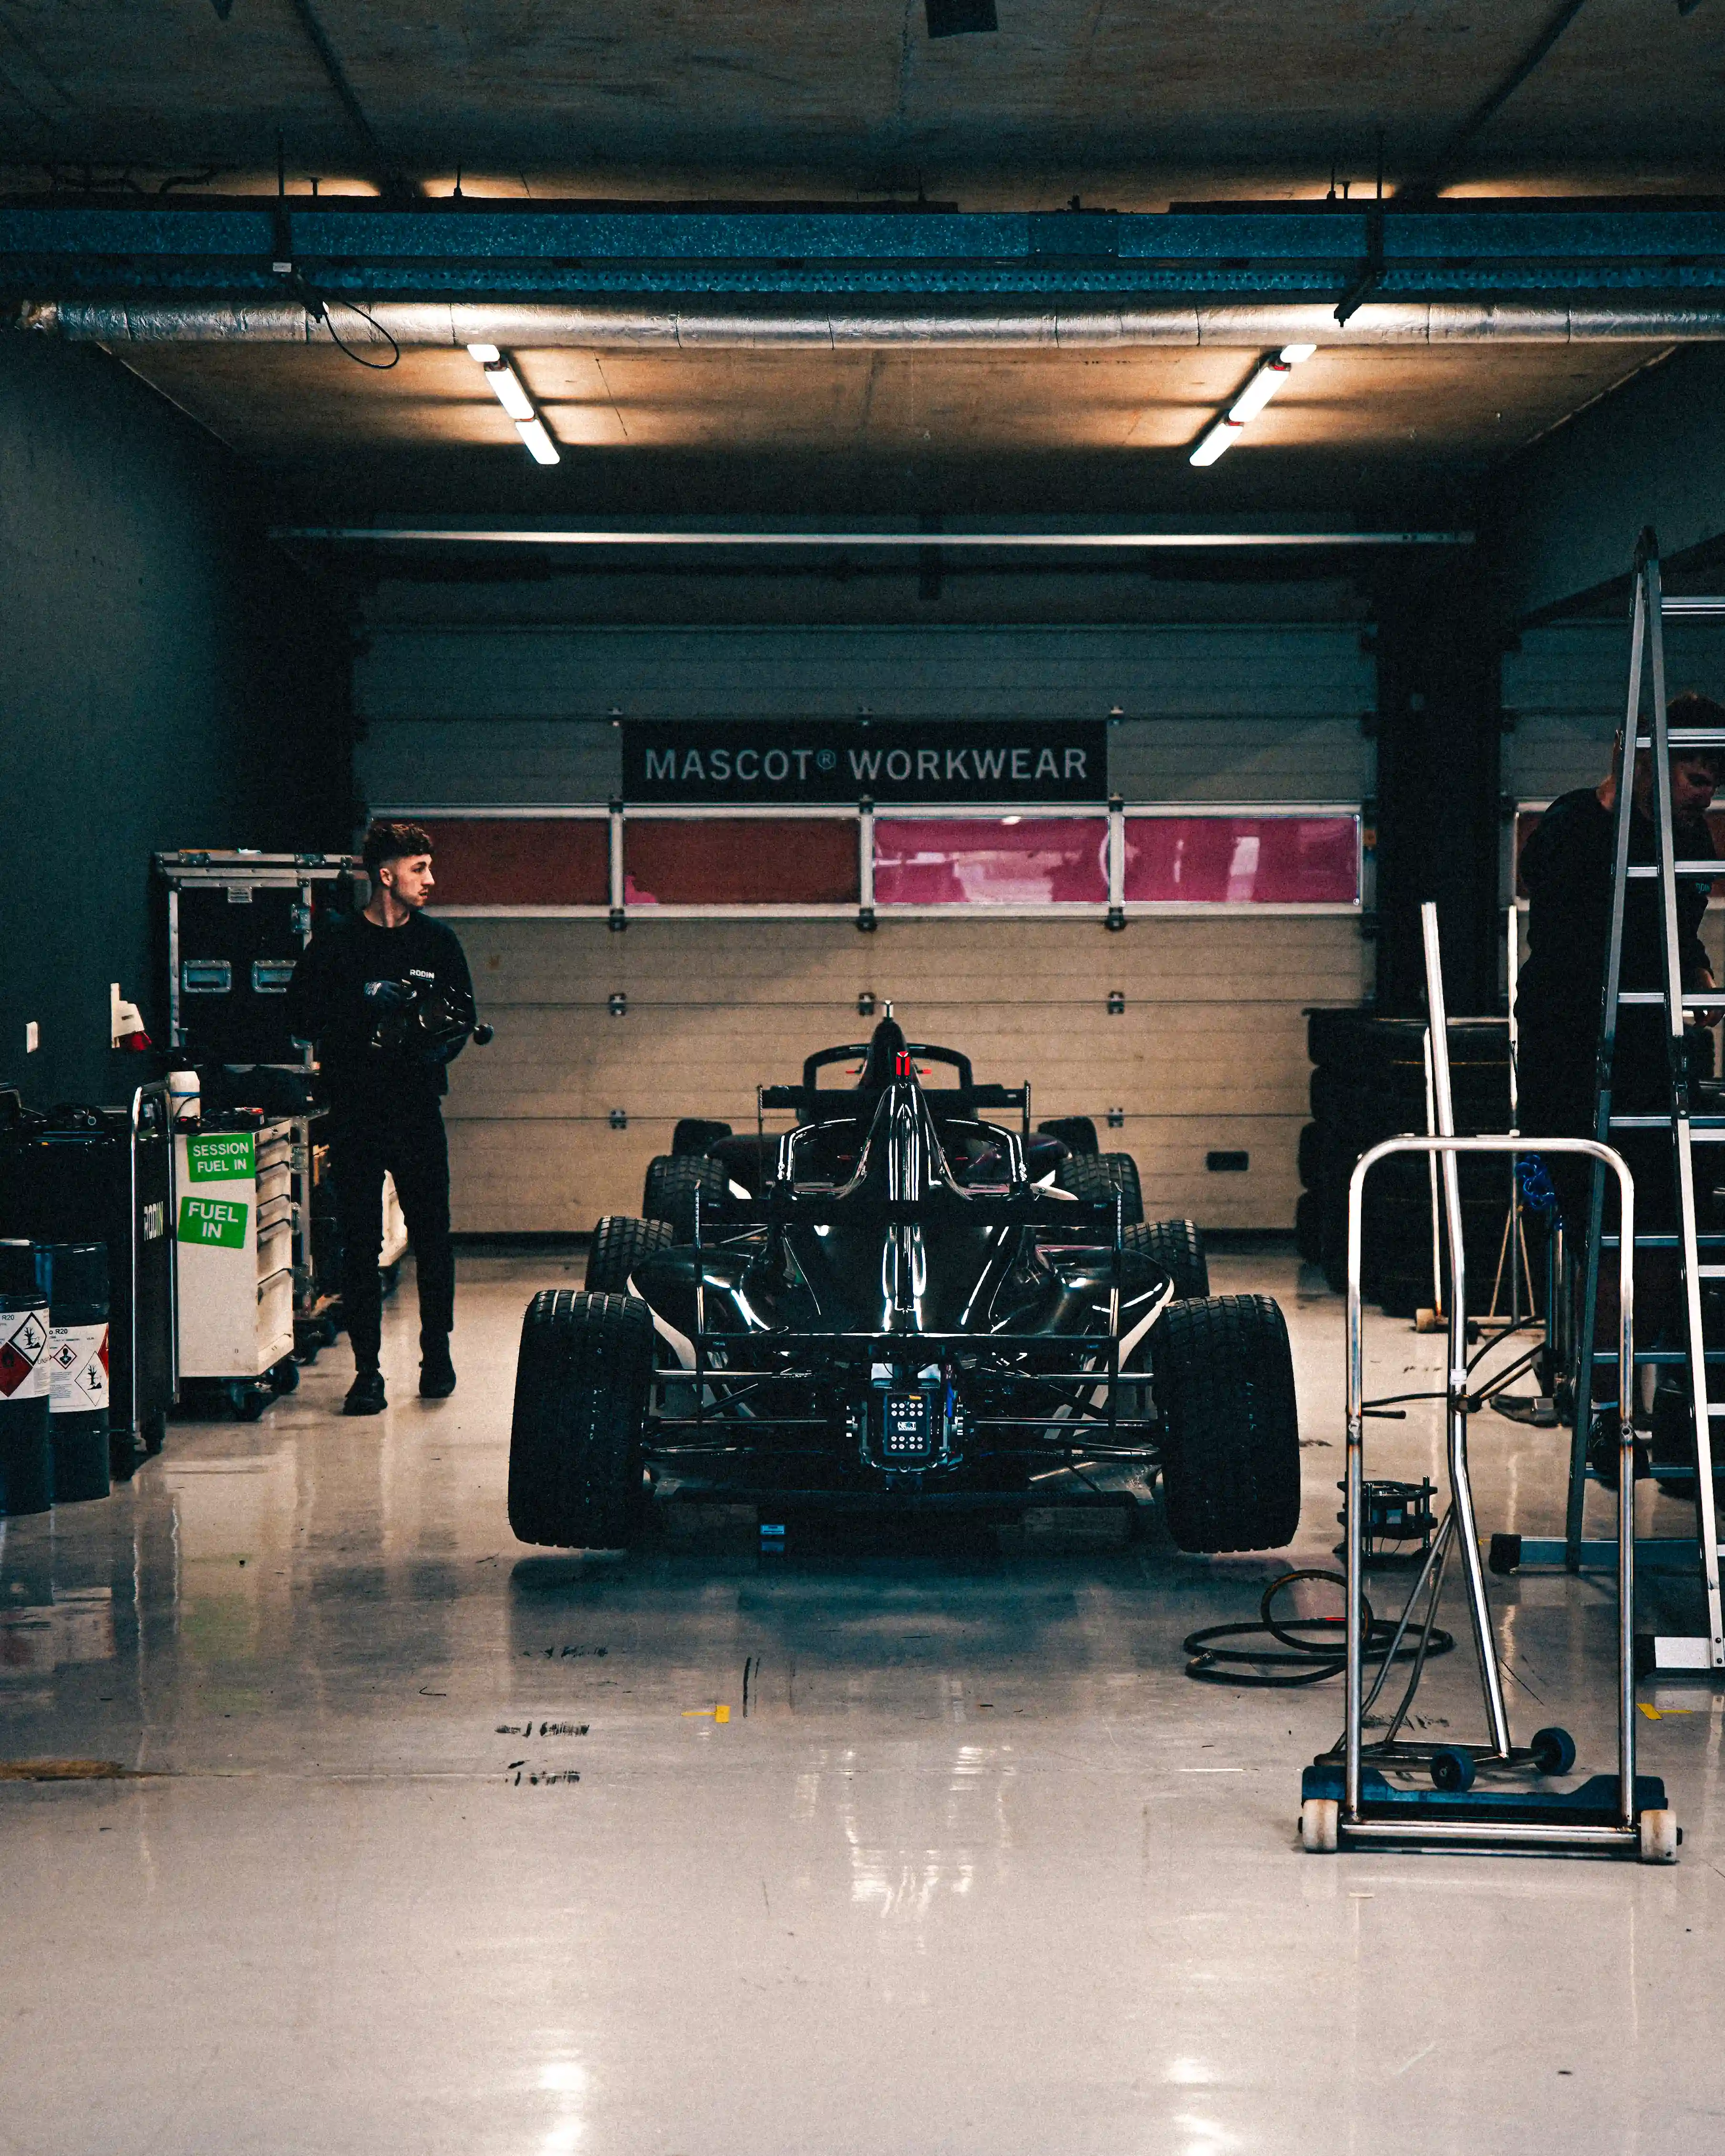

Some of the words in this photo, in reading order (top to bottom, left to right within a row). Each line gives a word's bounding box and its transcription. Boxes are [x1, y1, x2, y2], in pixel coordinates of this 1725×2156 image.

[848, 748, 1087, 780] WORKWEAR
[410, 969, 434, 979] RODIN
[193, 1142, 249, 1157] SESSION
[197, 1160, 229, 1173] FUEL
[234, 1159, 247, 1170] IN
[188, 1201, 238, 1223] FUEL
[144, 1201, 163, 1242] RODIN
[202, 1222, 222, 1238] IN
